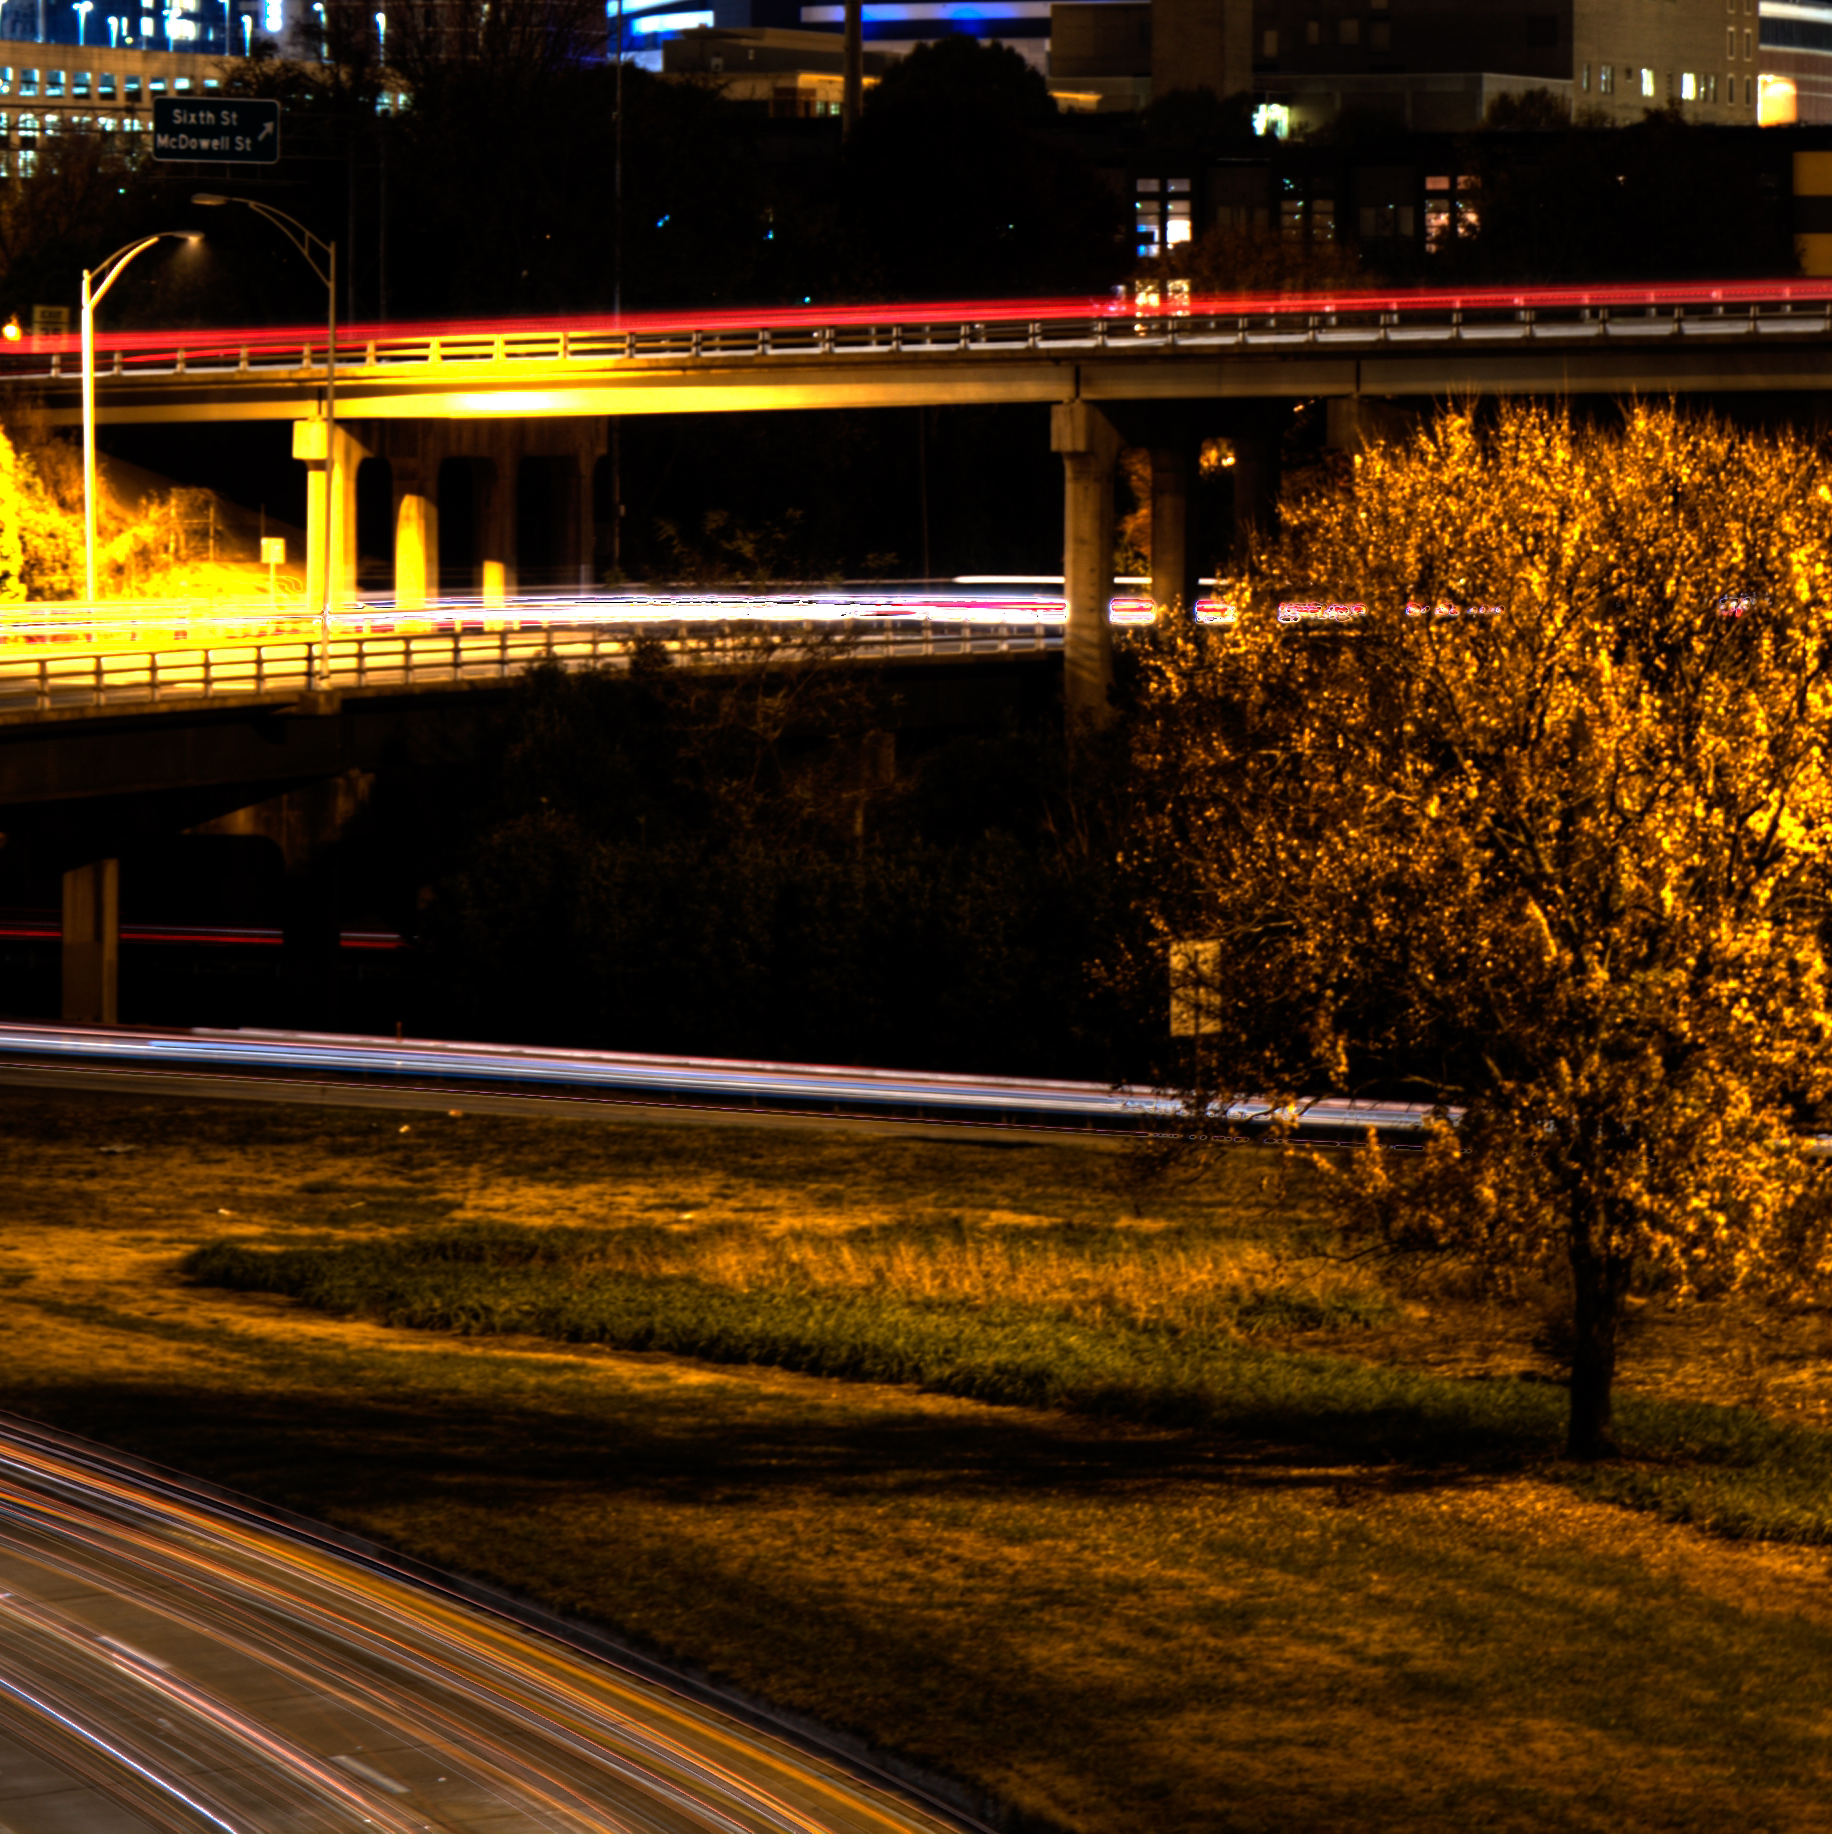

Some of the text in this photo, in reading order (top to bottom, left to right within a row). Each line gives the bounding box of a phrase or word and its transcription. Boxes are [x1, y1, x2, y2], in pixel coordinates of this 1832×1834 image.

[172, 108, 238, 127] Sixth St
[156, 133, 252, 153] McDowell St
